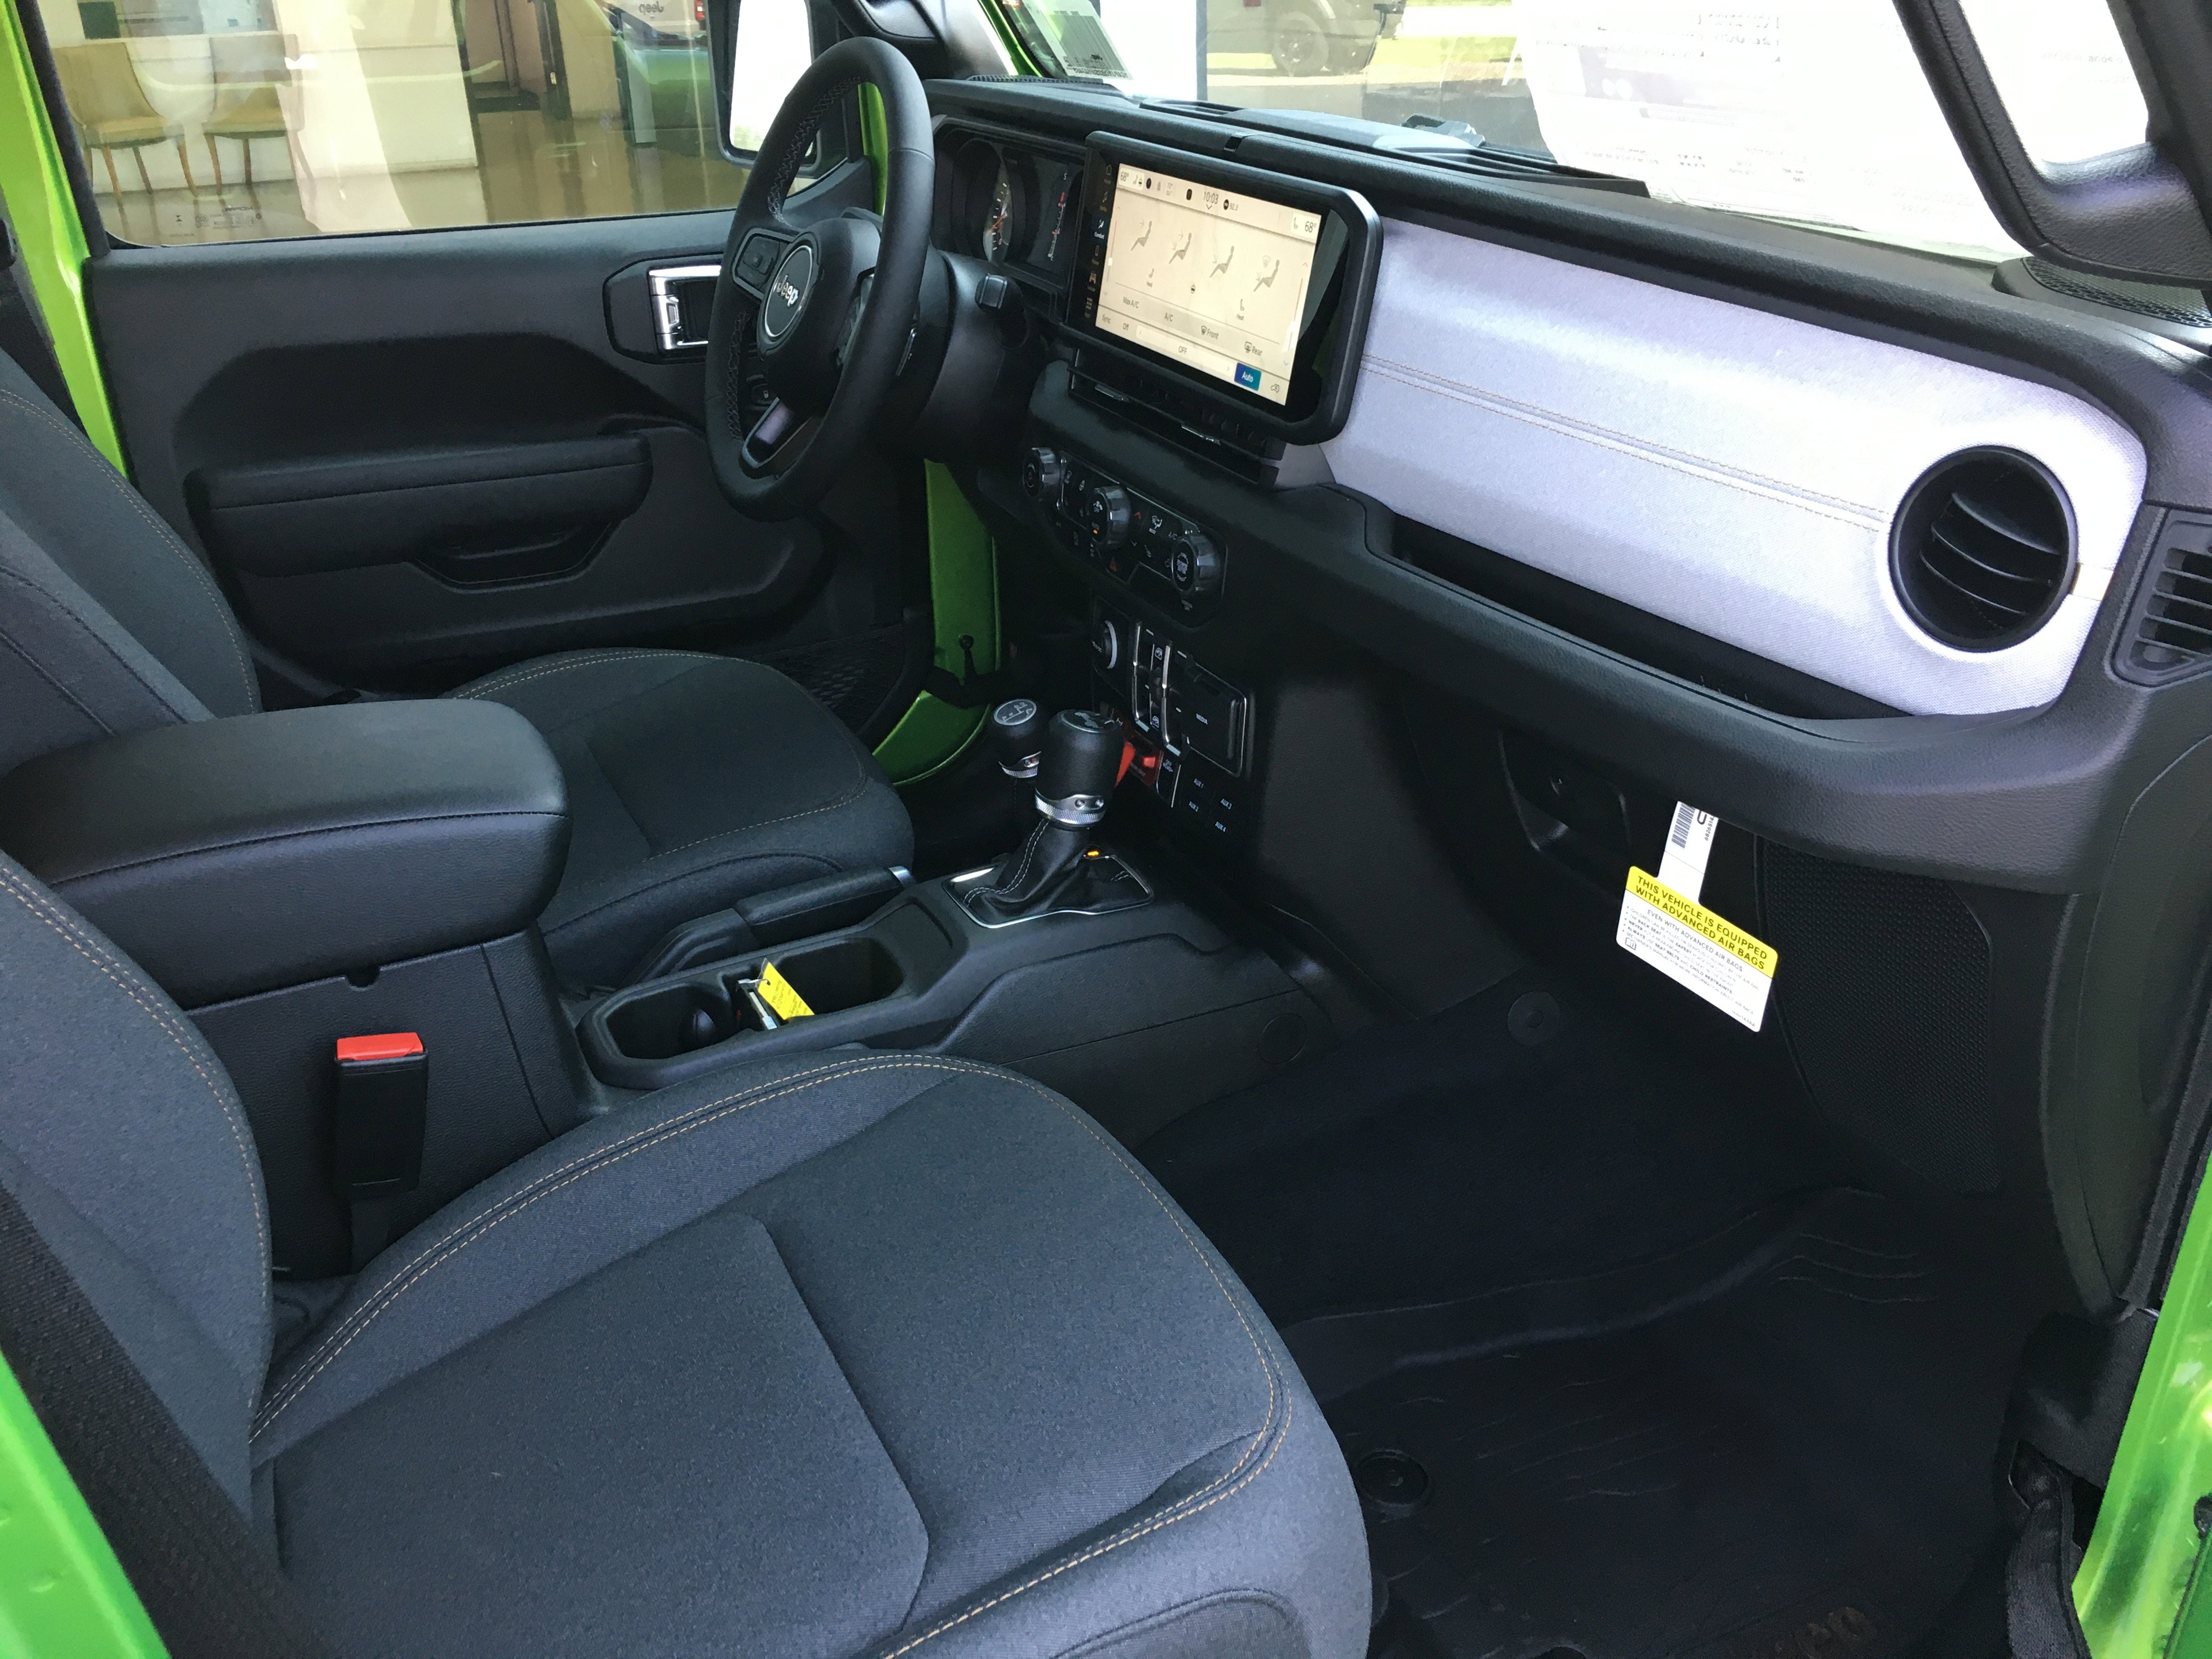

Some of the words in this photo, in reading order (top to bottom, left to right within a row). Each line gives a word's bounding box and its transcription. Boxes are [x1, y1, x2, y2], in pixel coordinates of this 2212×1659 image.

[1203, 191, 1219, 205] 10:03
[1305, 221, 1317, 233] 68°
[776, 274, 798, 307] Jeep
[1102, 314, 1111, 324] Sync
[1164, 312, 1173, 322] A/C
[1206, 329, 1219, 340] Front
[1178, 346, 1188, 354] OFF
[1252, 346, 1263, 357] Rear
[1241, 371, 1254, 383] Auto
[1705, 815, 1715, 841] 6826514
[1637, 875, 1659, 894] THIS
[1661, 889, 1702, 921] VEHICLE
[1704, 916, 1714, 928] IS
[1716, 923, 1768, 961] EQUIPPED
[1635, 885, 1660, 906] WITH
[1662, 901, 1716, 940] ADVANCED
[1718, 935, 1735, 951] AIR
[1737, 947, 1765, 970] BAGS
[1647, 909, 1662, 922] EVEN
[1664, 919, 1679, 933] WITH
[1680, 929, 1713, 953] ADVANCED
[1714, 950, 1725, 961] AIR
[1726, 957, 1743, 972] BAGS
